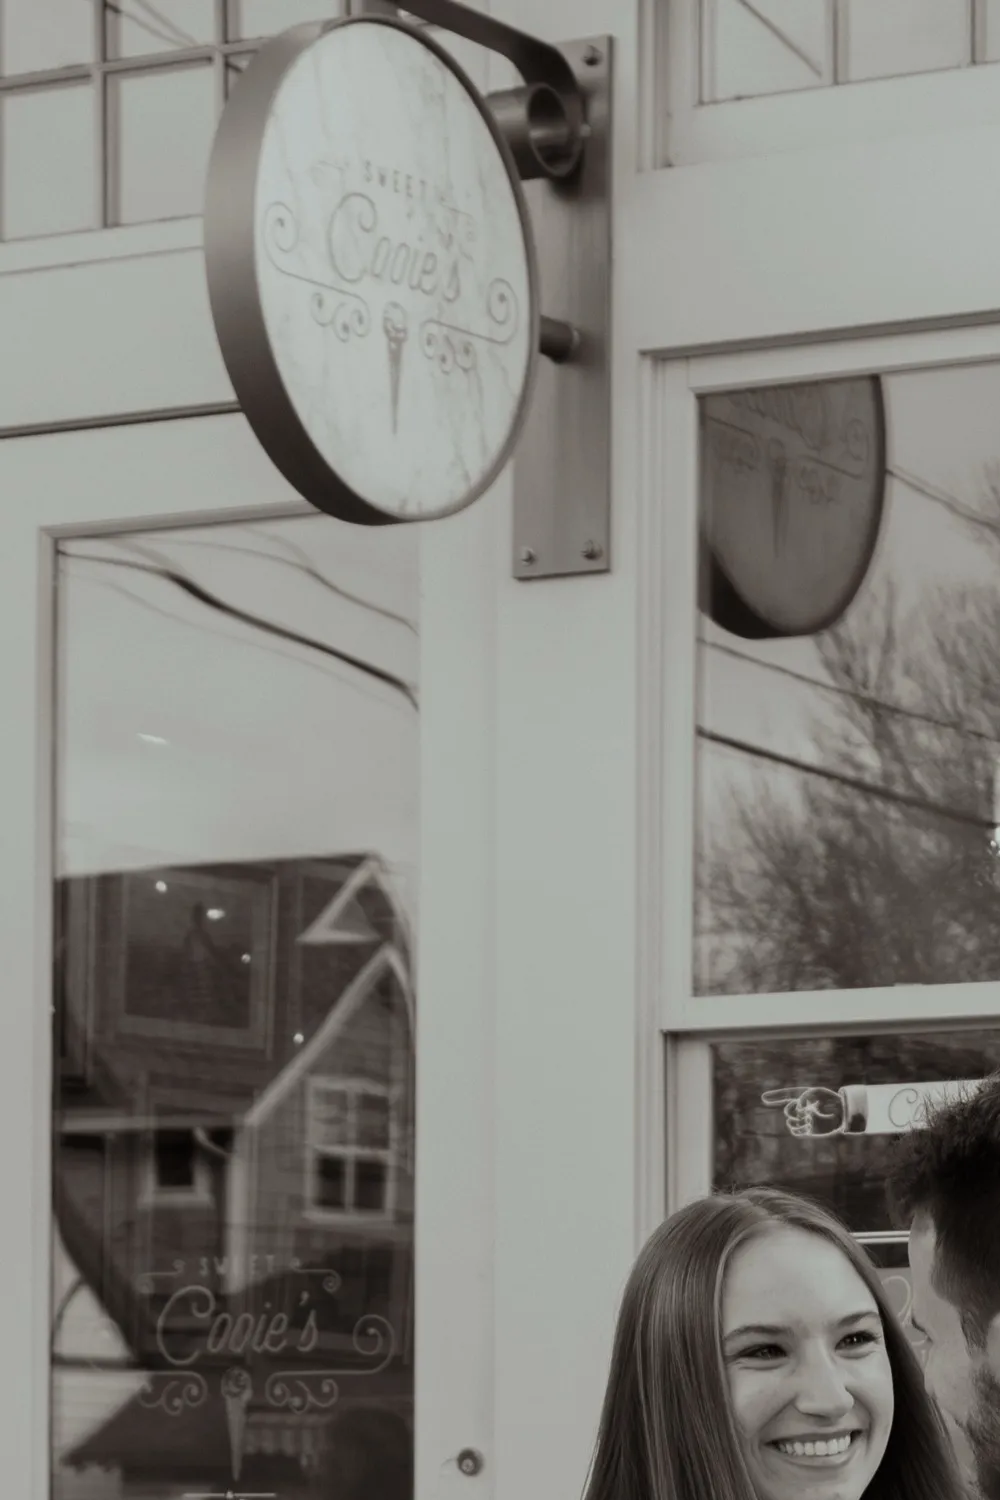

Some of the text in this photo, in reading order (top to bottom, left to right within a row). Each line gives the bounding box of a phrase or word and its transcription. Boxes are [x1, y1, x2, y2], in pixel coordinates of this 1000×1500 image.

[363, 158, 428, 204] SWEET
[200, 1254, 275, 1277] SWET
[156, 1284, 318, 1366] Cooie's
